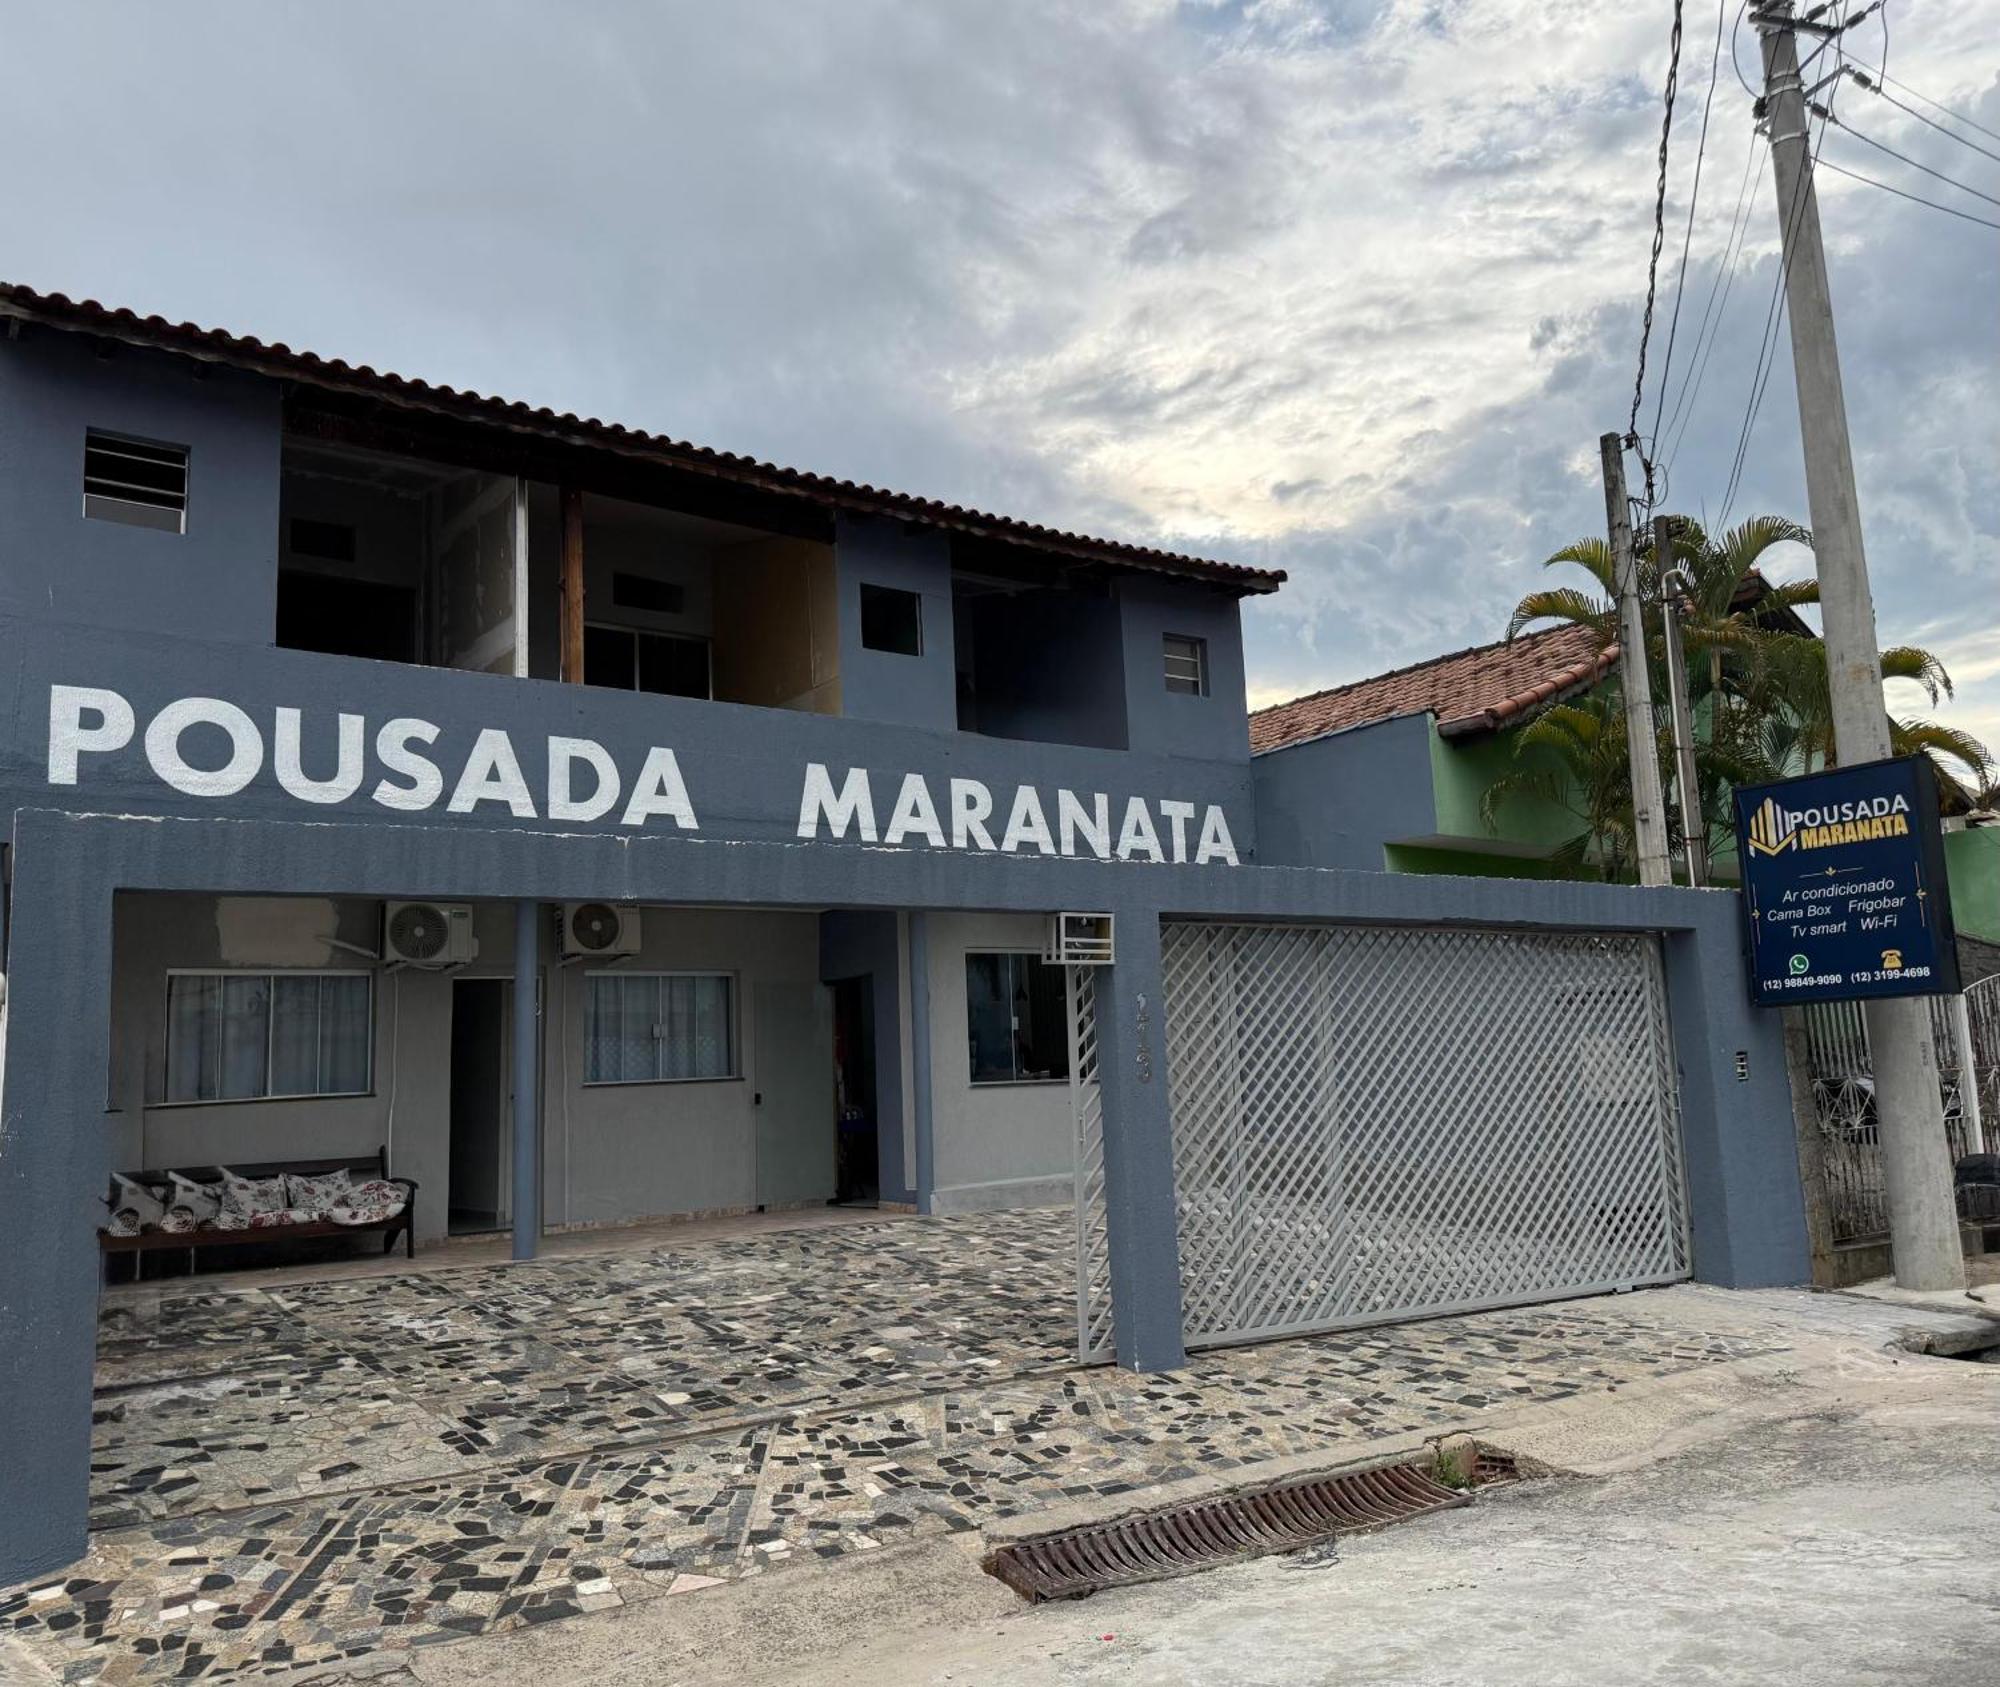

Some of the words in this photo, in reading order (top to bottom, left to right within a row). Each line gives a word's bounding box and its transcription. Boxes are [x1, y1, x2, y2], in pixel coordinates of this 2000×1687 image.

[48, 684, 699, 828] POUSADA
[797, 763, 1239, 866] MARANATA
[1789, 794, 1910, 830] POUSADA
[1801, 813, 1909, 850] MARANATA
[1782, 889, 1799, 903] Ar
[1801, 878, 1895, 900] condicionado
[1767, 908, 1803, 922] Cama
[1807, 904, 1832, 918] Box
[1848, 896, 1906, 914] Frigobar
[1791, 925, 1807, 938] Tv
[1810, 921, 1847, 937] smart
[1860, 914, 1898, 931] Wi-Fi
[1763, 980, 1783, 992] (12)
[1784, 974, 1843, 988] 98849-9090
[1851, 970, 1872, 983] (12)
[1873, 966, 1931, 980] 3199-4698
